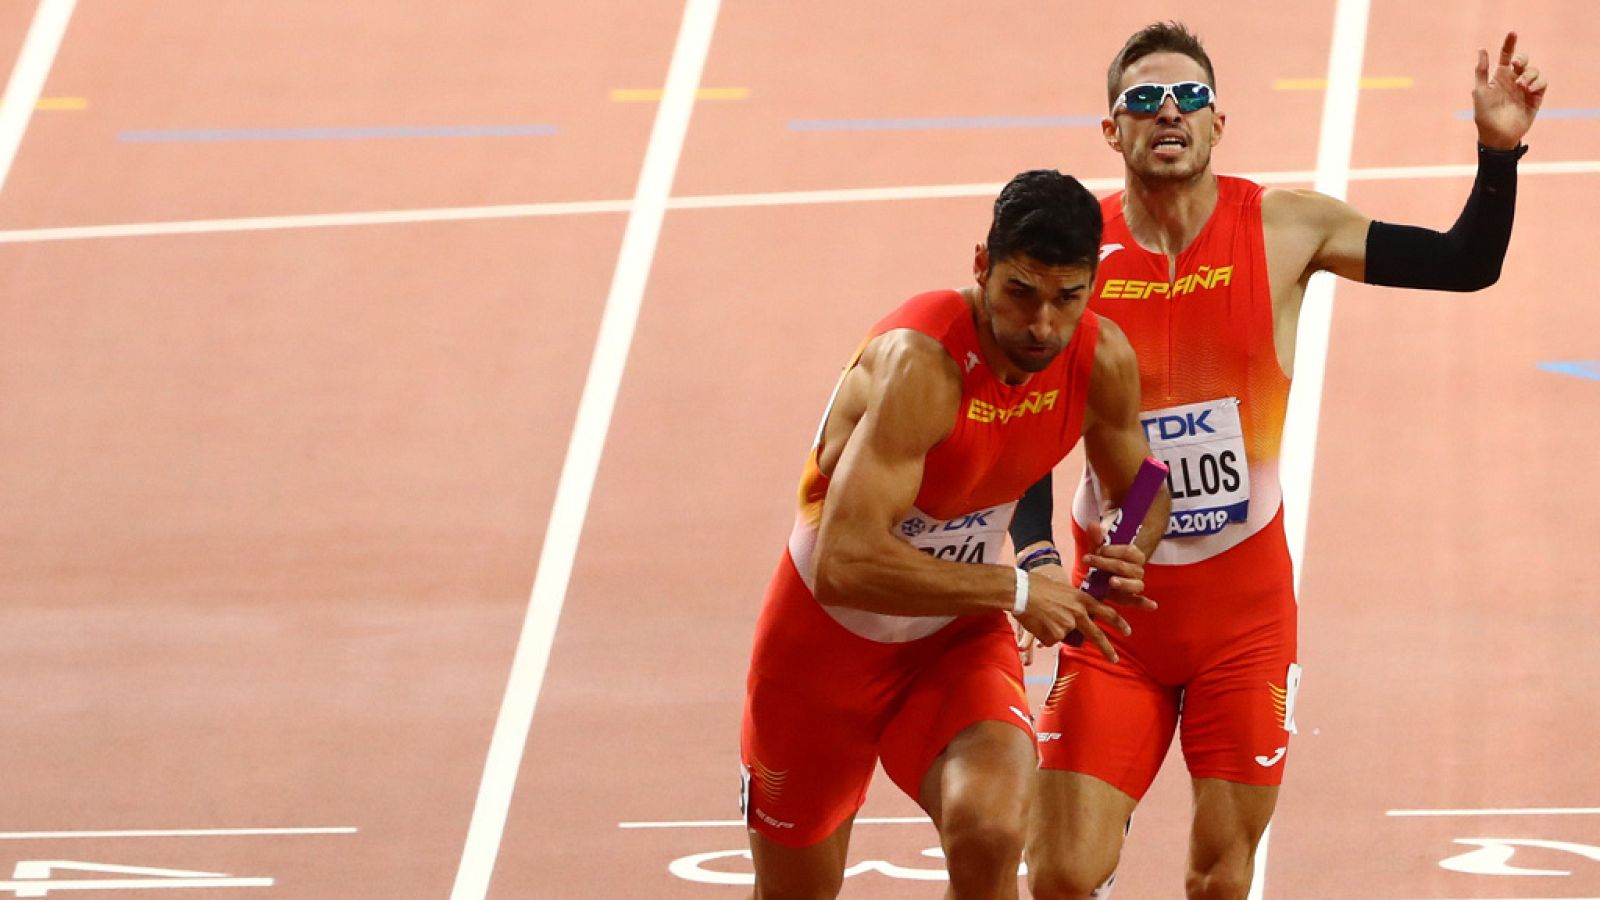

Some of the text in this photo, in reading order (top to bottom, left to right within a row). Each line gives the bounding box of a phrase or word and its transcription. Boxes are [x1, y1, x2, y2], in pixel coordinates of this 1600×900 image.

[1100, 264, 1234, 300] ESPAÑA
[1140, 409, 1215, 441] TDK
[1168, 510, 1229, 533] A2019
